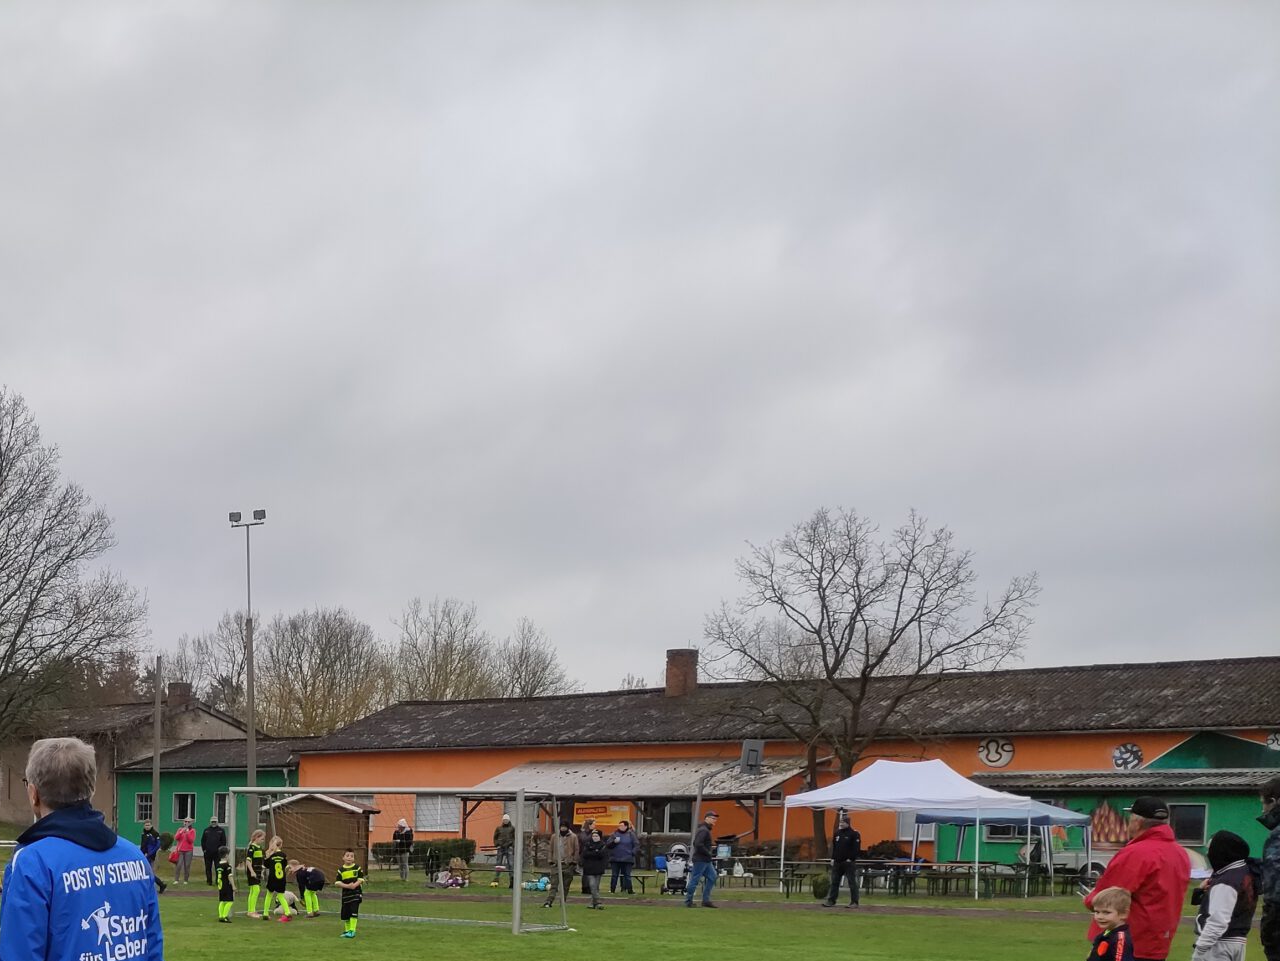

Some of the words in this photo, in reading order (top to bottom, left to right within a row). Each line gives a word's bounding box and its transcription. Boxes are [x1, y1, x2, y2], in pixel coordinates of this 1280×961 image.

[62, 867, 92, 894] POST
[92, 864, 106, 887] SV
[107, 860, 150, 884] STENDAL
[274, 861, 284, 880] 8
